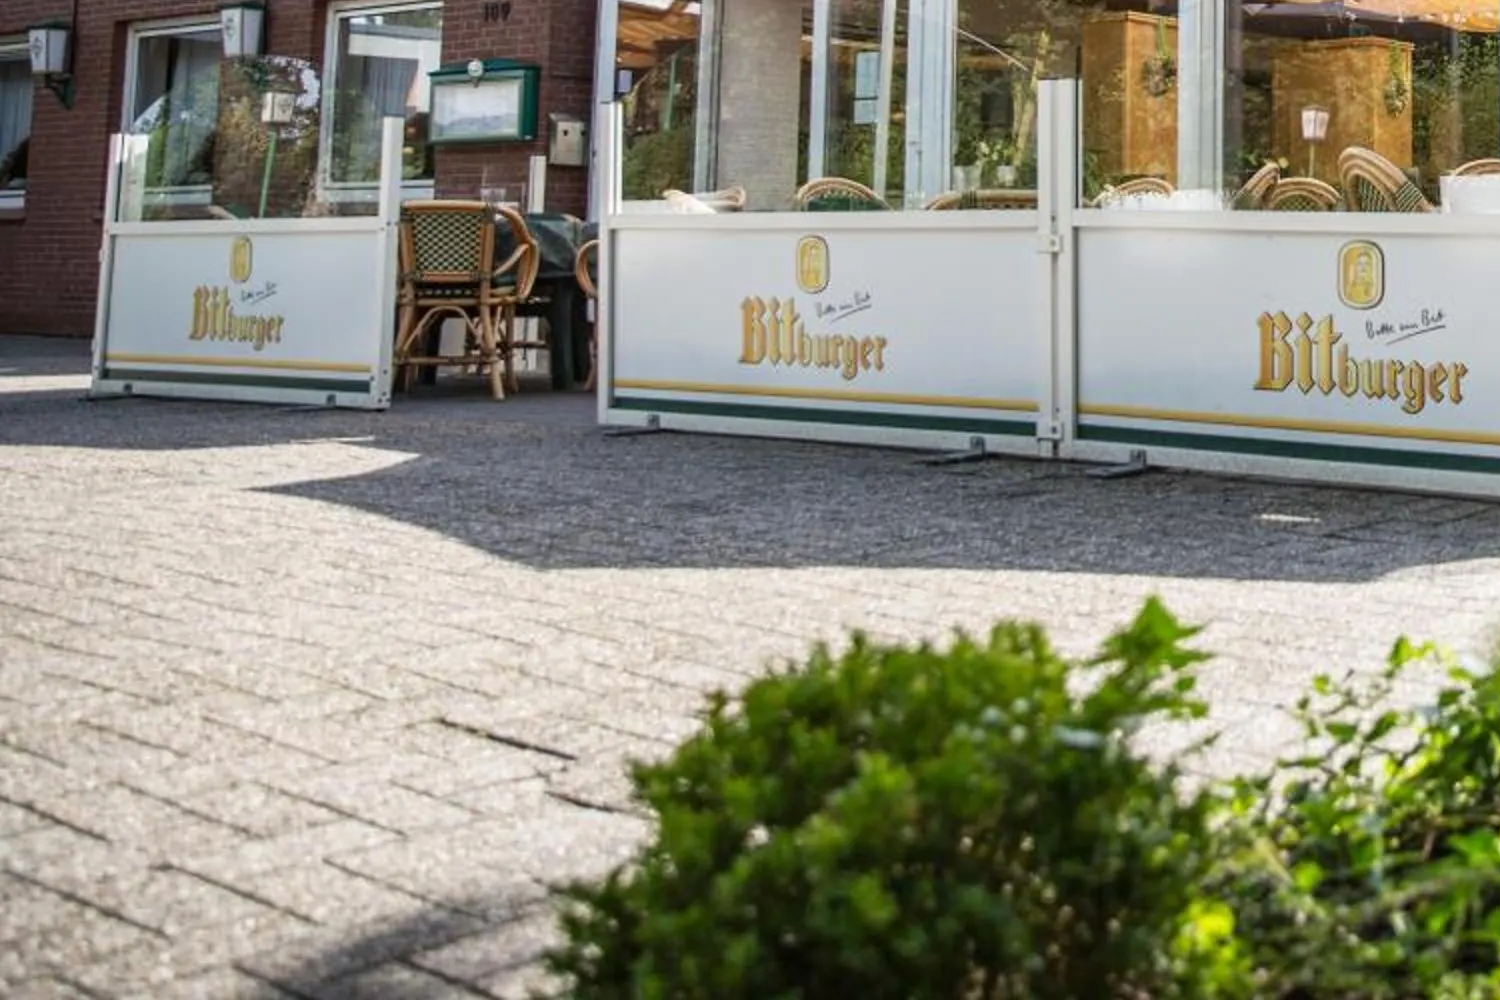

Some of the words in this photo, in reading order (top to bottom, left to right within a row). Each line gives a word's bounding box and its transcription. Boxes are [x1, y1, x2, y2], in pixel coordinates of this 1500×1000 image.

[188, 284, 285, 351] Bitburger
[738, 295, 887, 381] Bitburger
[1253, 310, 1468, 415] Bitburger
